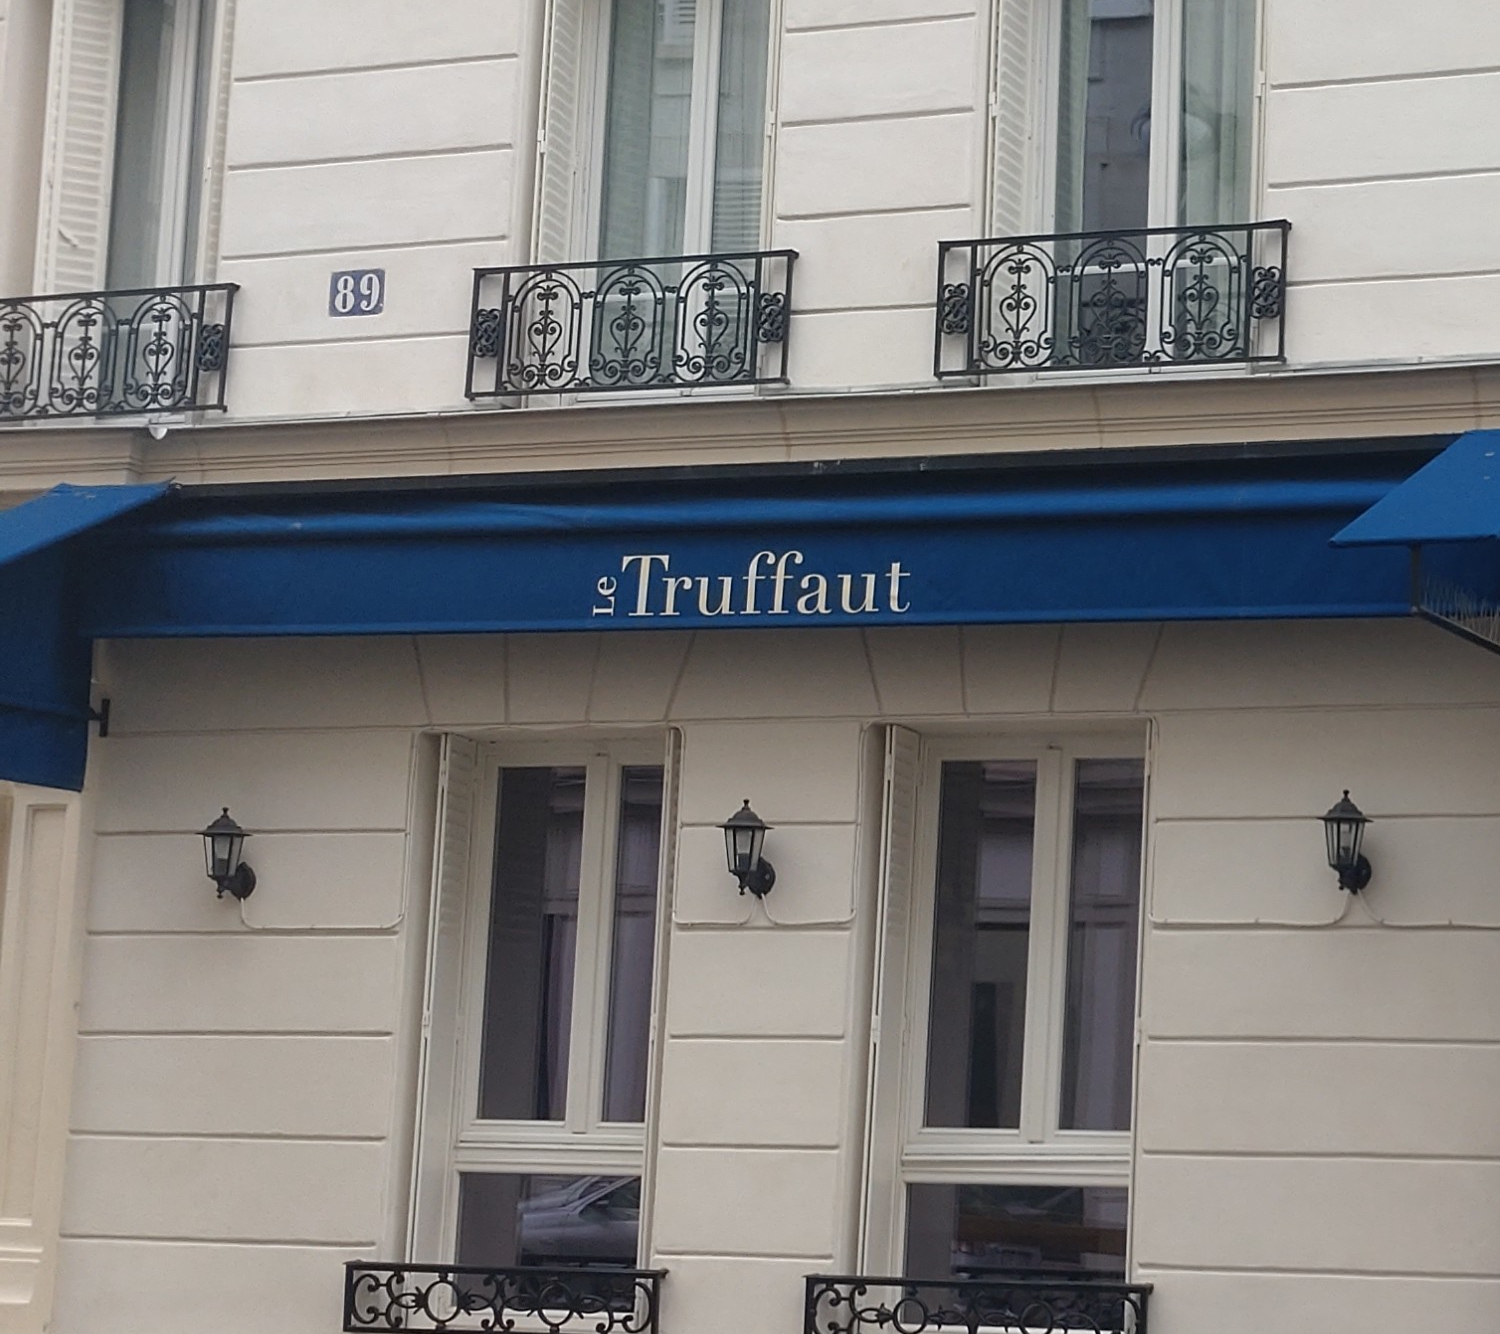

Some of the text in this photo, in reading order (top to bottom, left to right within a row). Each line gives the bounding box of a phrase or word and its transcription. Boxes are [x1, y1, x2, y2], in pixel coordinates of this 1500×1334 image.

[334, 273, 380, 313] 89
[592, 550, 911, 617] Le Truffaut
